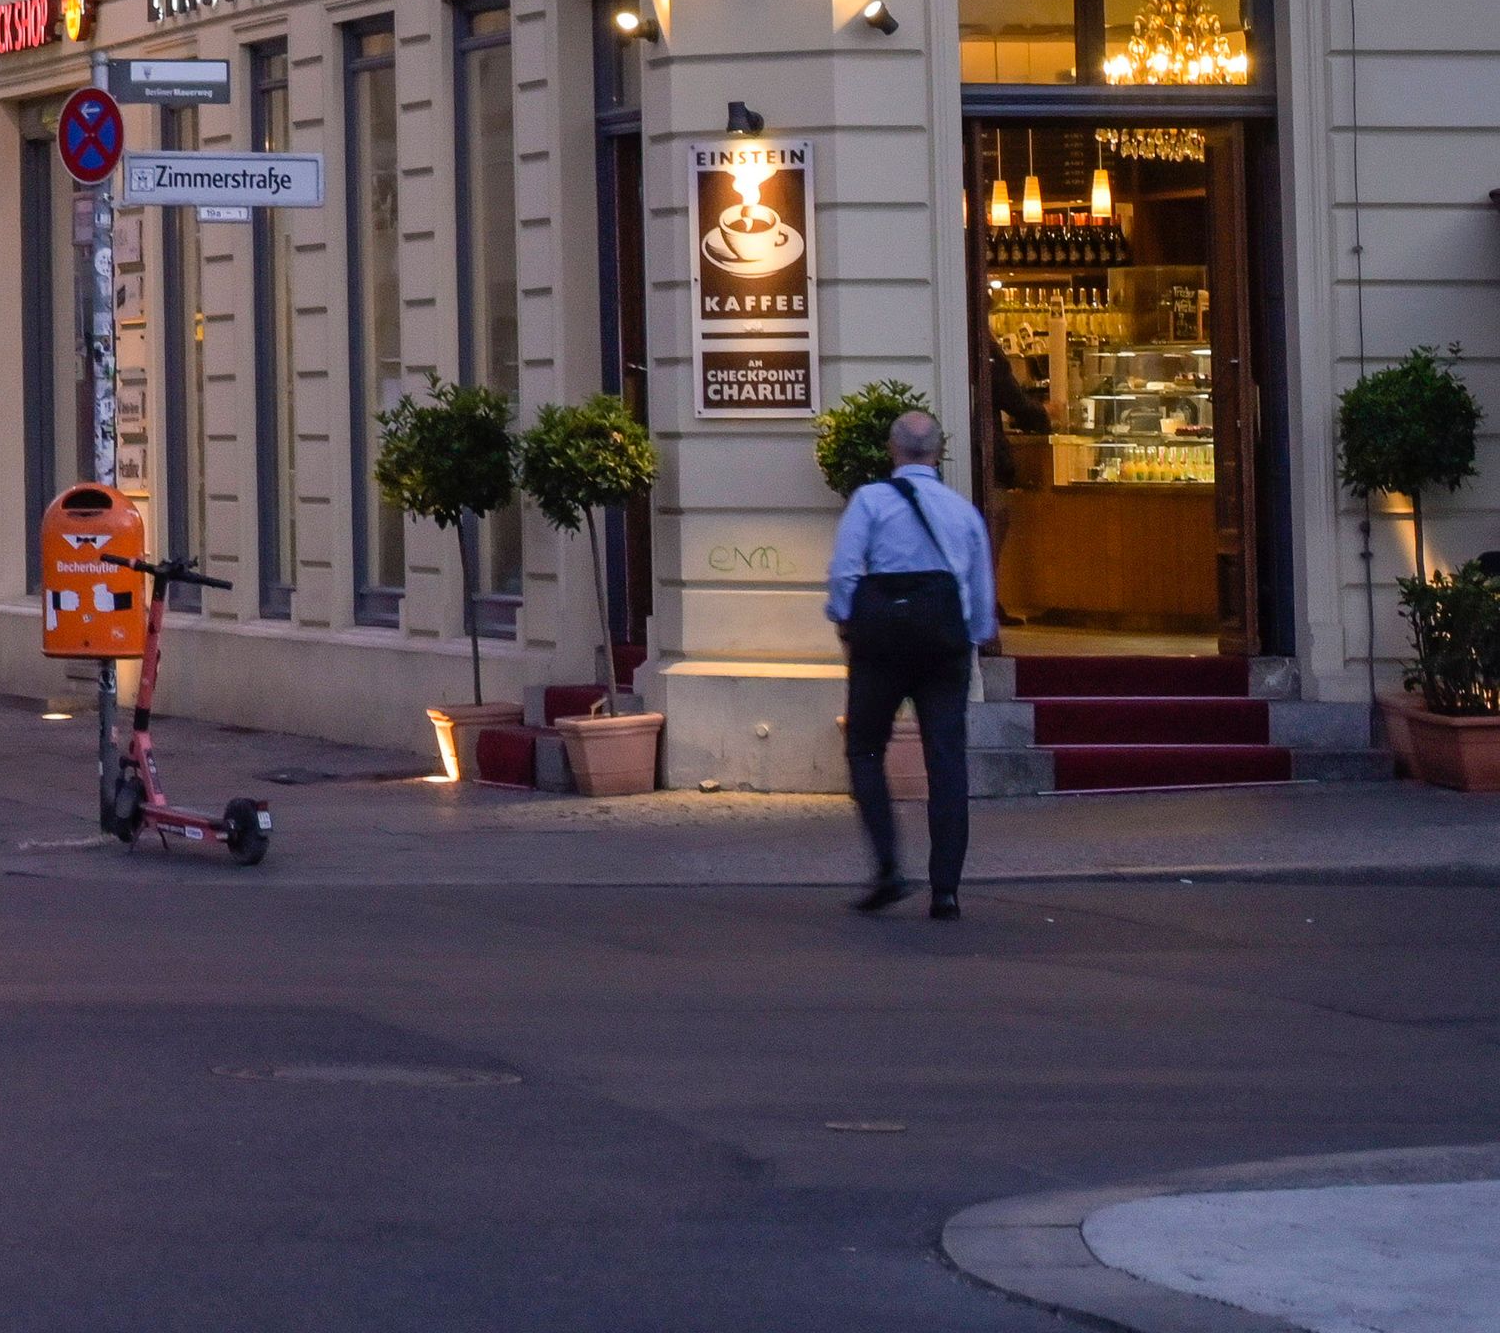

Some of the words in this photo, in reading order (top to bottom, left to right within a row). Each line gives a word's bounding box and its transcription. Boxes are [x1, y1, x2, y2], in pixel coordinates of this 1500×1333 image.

[696, 149, 805, 166] EINSTEIN
[155, 164, 292, 195] Zimmerstraße
[206, 208, 221, 218] 19a
[705, 295, 805, 312] KAFFEE
[707, 369, 805, 383] CHECKPOINT
[707, 383, 806, 401] CHARLIE
